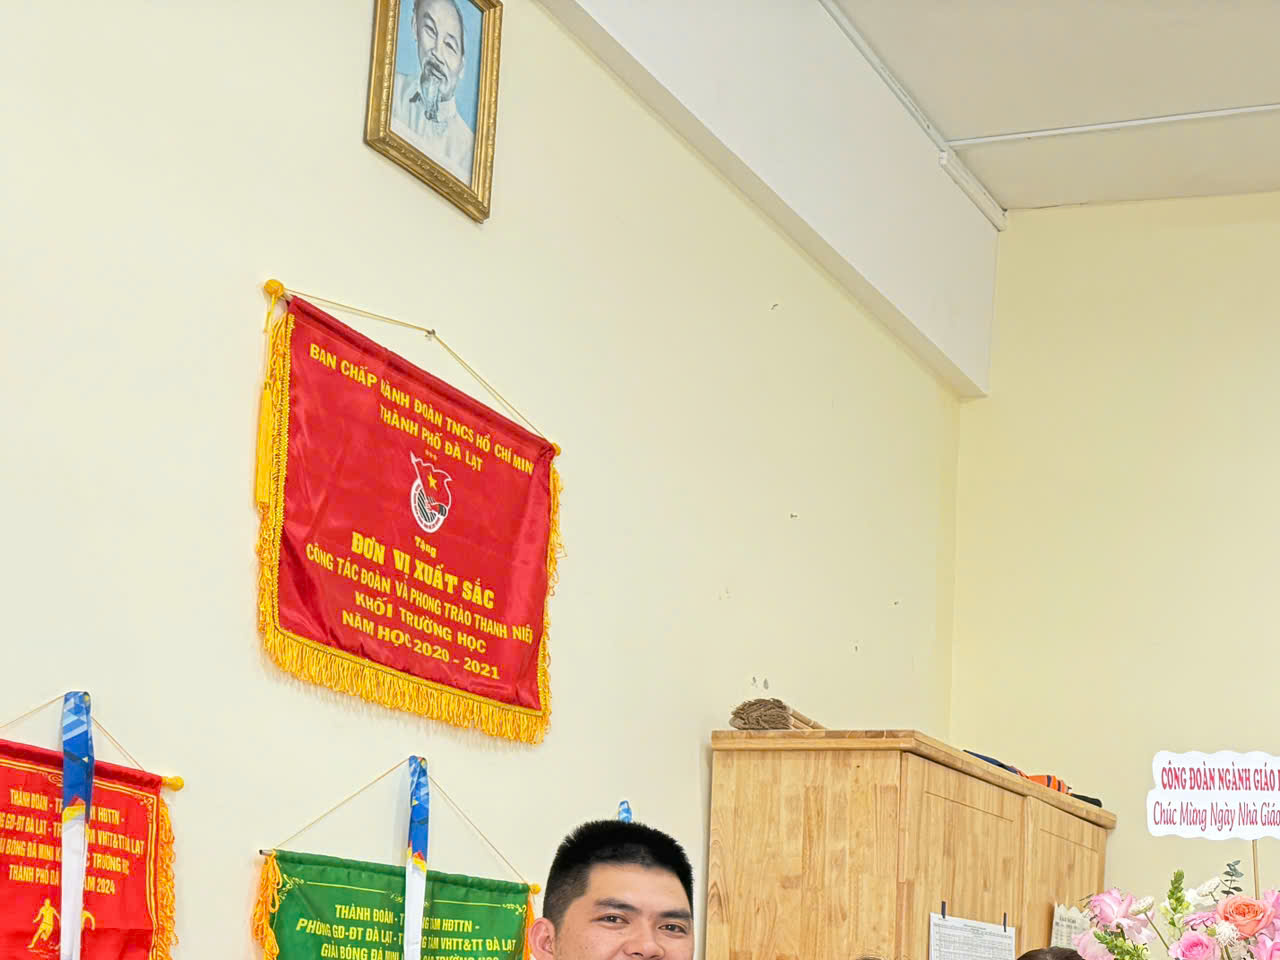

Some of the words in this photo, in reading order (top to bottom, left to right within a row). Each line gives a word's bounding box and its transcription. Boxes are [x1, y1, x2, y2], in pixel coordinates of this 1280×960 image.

[310, 343, 337, 370] BAN
[340, 360, 377, 388] CHẤP
[414, 399, 443, 427] ĐOÀN
[446, 416, 474, 443] TNCS
[476, 432, 491, 453] HỒ
[494, 443, 512, 464] CHÍ
[380, 402, 419, 437] THÀNH
[422, 426, 443, 450] PHỐ
[444, 440, 462, 460] ĐÀ
[465, 450, 483, 472] LẠT
[351, 531, 385, 565] ĐƠN
[393, 548, 411, 579] VỊ
[413, 558, 459, 594] XUẤT
[462, 577, 495, 609] SẮC
[306, 542, 334, 572] CÔNG
[336, 556, 359, 581] TÁC
[361, 567, 391, 594] ĐOÀN
[395, 579, 409, 601] VÀ
[410, 587, 442, 616] PHONG
[444, 602, 472, 626] TRÀO
[474, 613, 508, 639] THANH
[355, 590, 393, 618] KHỐI
[399, 607, 452, 642] TRƯỜNG
[457, 631, 486, 654] HỌC
[342, 609, 374, 636] NĂM
[377, 624, 412, 648] HỌC
[414, 639, 450, 663] 2020
[463, 657, 500, 680] 2021
[1161, 760, 1187, 791] CÔNG
[1189, 761, 1216, 791] ĐOÀN
[1217, 761, 1251, 791] NGÀNH
[1253, 762, 1276, 791] GIÁO
[1153, 800, 1177, 826] Chúc
[1179, 802, 1207, 832] Mừng
[1210, 802, 1236, 832] Ngày
[1238, 801, 1258, 827] Nhà
[1260, 801, 1280, 827] Giáo
[131, 839, 145, 858] LẠT
[9, 862, 34, 883] THÀNH
[97, 877, 116, 896] 2024
[296, 917, 331, 937] PHÒNG
[332, 925, 364, 940] GD-ĐT
[365, 925, 379, 942] ĐÀ
[441, 937, 484, 951] VHTT&TT
[486, 936, 500, 951] ĐÀ
[502, 939, 516, 954] LẠT
[335, 903, 371, 921] THÀNH
[373, 908, 394, 924] ĐOÀN
[442, 919, 473, 933] HĐTTN
[321, 940, 338, 958] GIẢI
[340, 944, 368, 960] BÓNG
